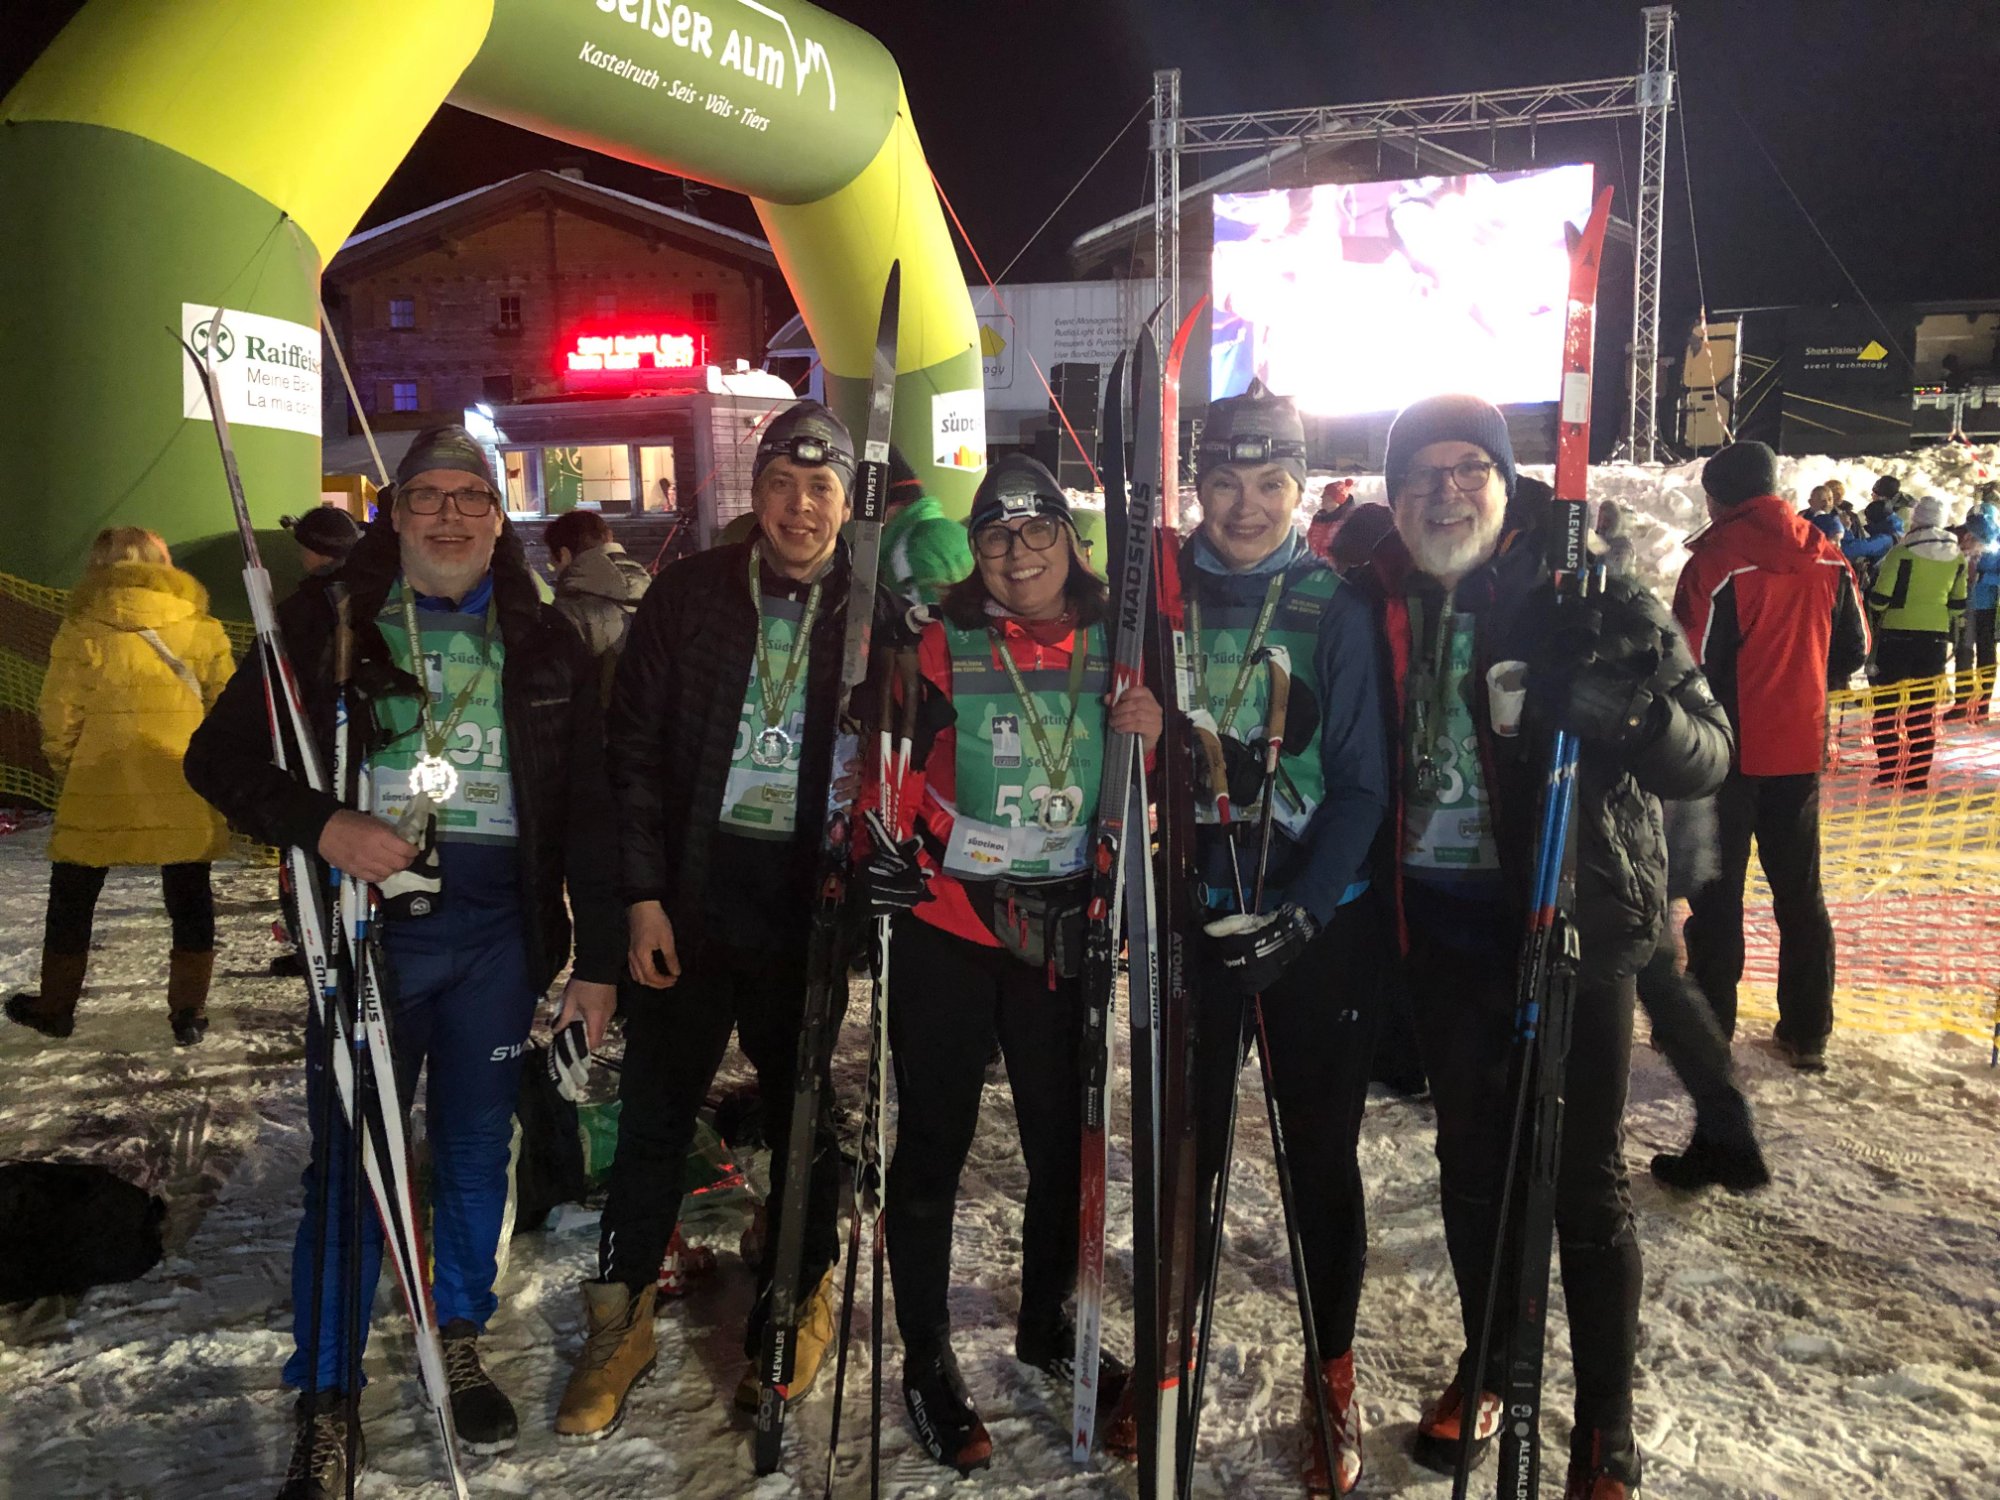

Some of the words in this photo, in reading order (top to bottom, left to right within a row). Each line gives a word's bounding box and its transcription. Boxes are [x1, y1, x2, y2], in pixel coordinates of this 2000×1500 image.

[578, 41, 660, 90] Kastelruth
[667, 79, 697, 104] Seis
[705, 94, 733, 119] Völs
[739, 108, 771, 132] Tiers
[247, 367, 290, 389] Meine
[1803, 362, 1830, 370] event
[247, 390, 266, 408] La
[864, 464, 877, 518] ALEWALDS
[1122, 482, 1150, 632] MADSHUS
[1566, 503, 1580, 570] ALEWALDS
[1109, 938, 1119, 1013] MADSHUS
[1150, 951, 1160, 1031] MADSHUS
[1171, 931, 1184, 1000] ATOMIC
[772, 1330, 785, 1383] ALEWALDS
[1511, 1404, 1533, 1418] C9
